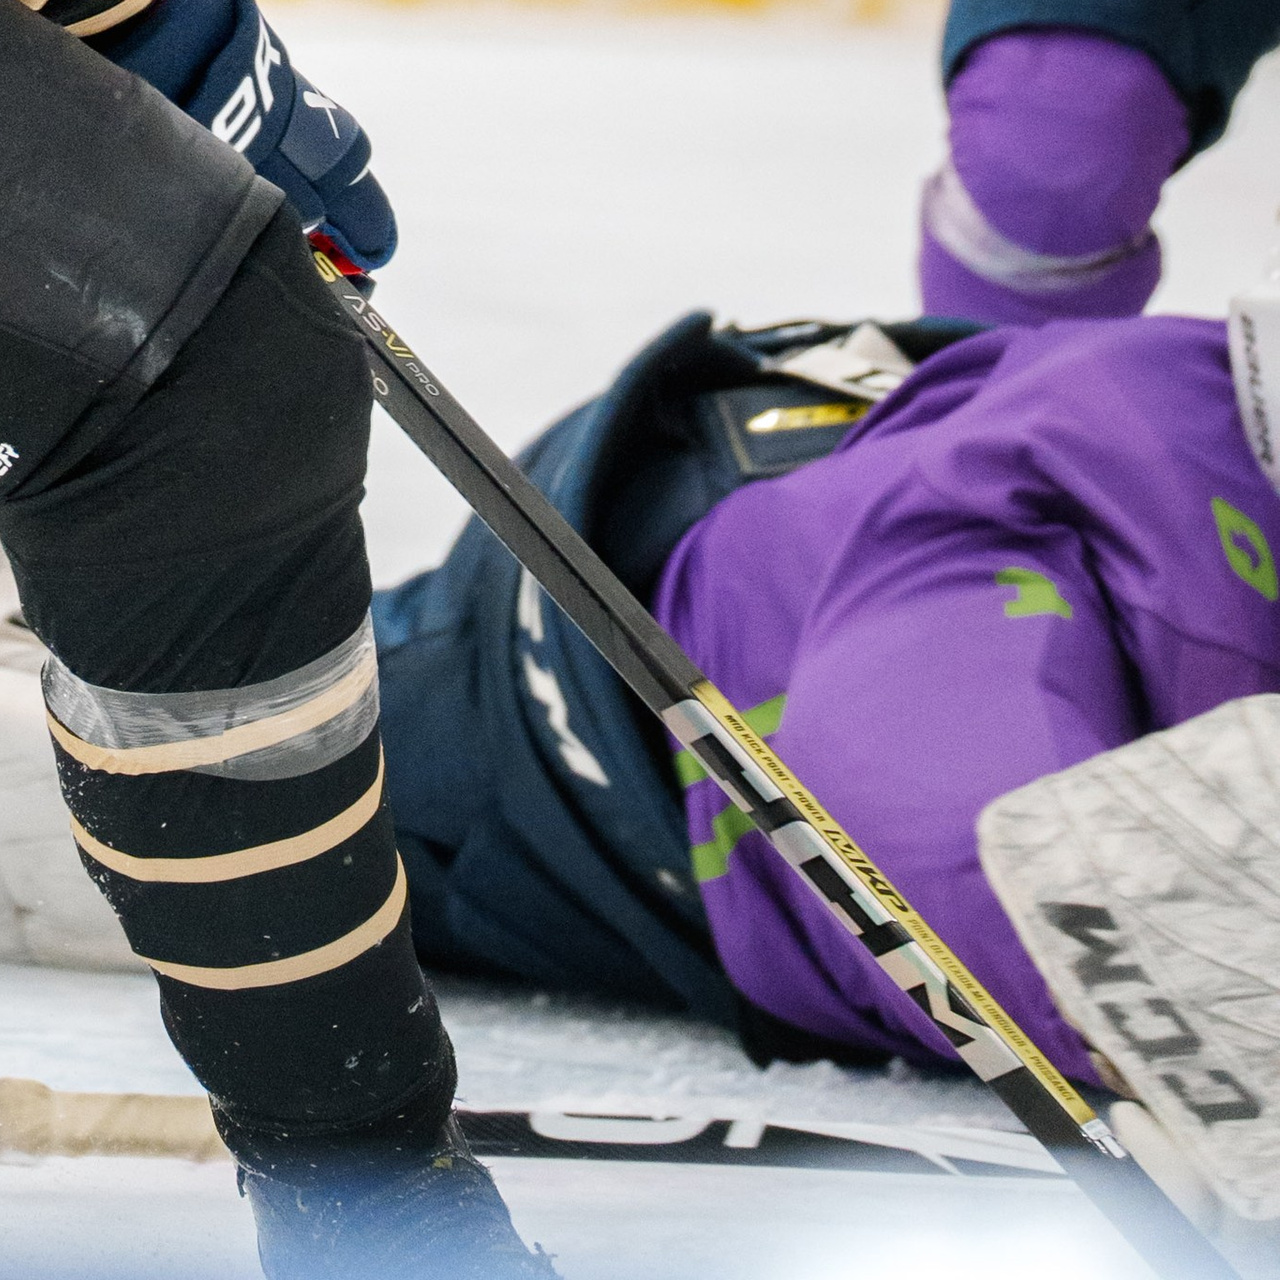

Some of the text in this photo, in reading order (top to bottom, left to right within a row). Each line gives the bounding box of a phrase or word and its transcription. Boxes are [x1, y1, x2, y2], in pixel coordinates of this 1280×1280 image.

[406, 362, 440, 397] PRO
[724, 713, 827, 823] MID KICK POINT POWER
